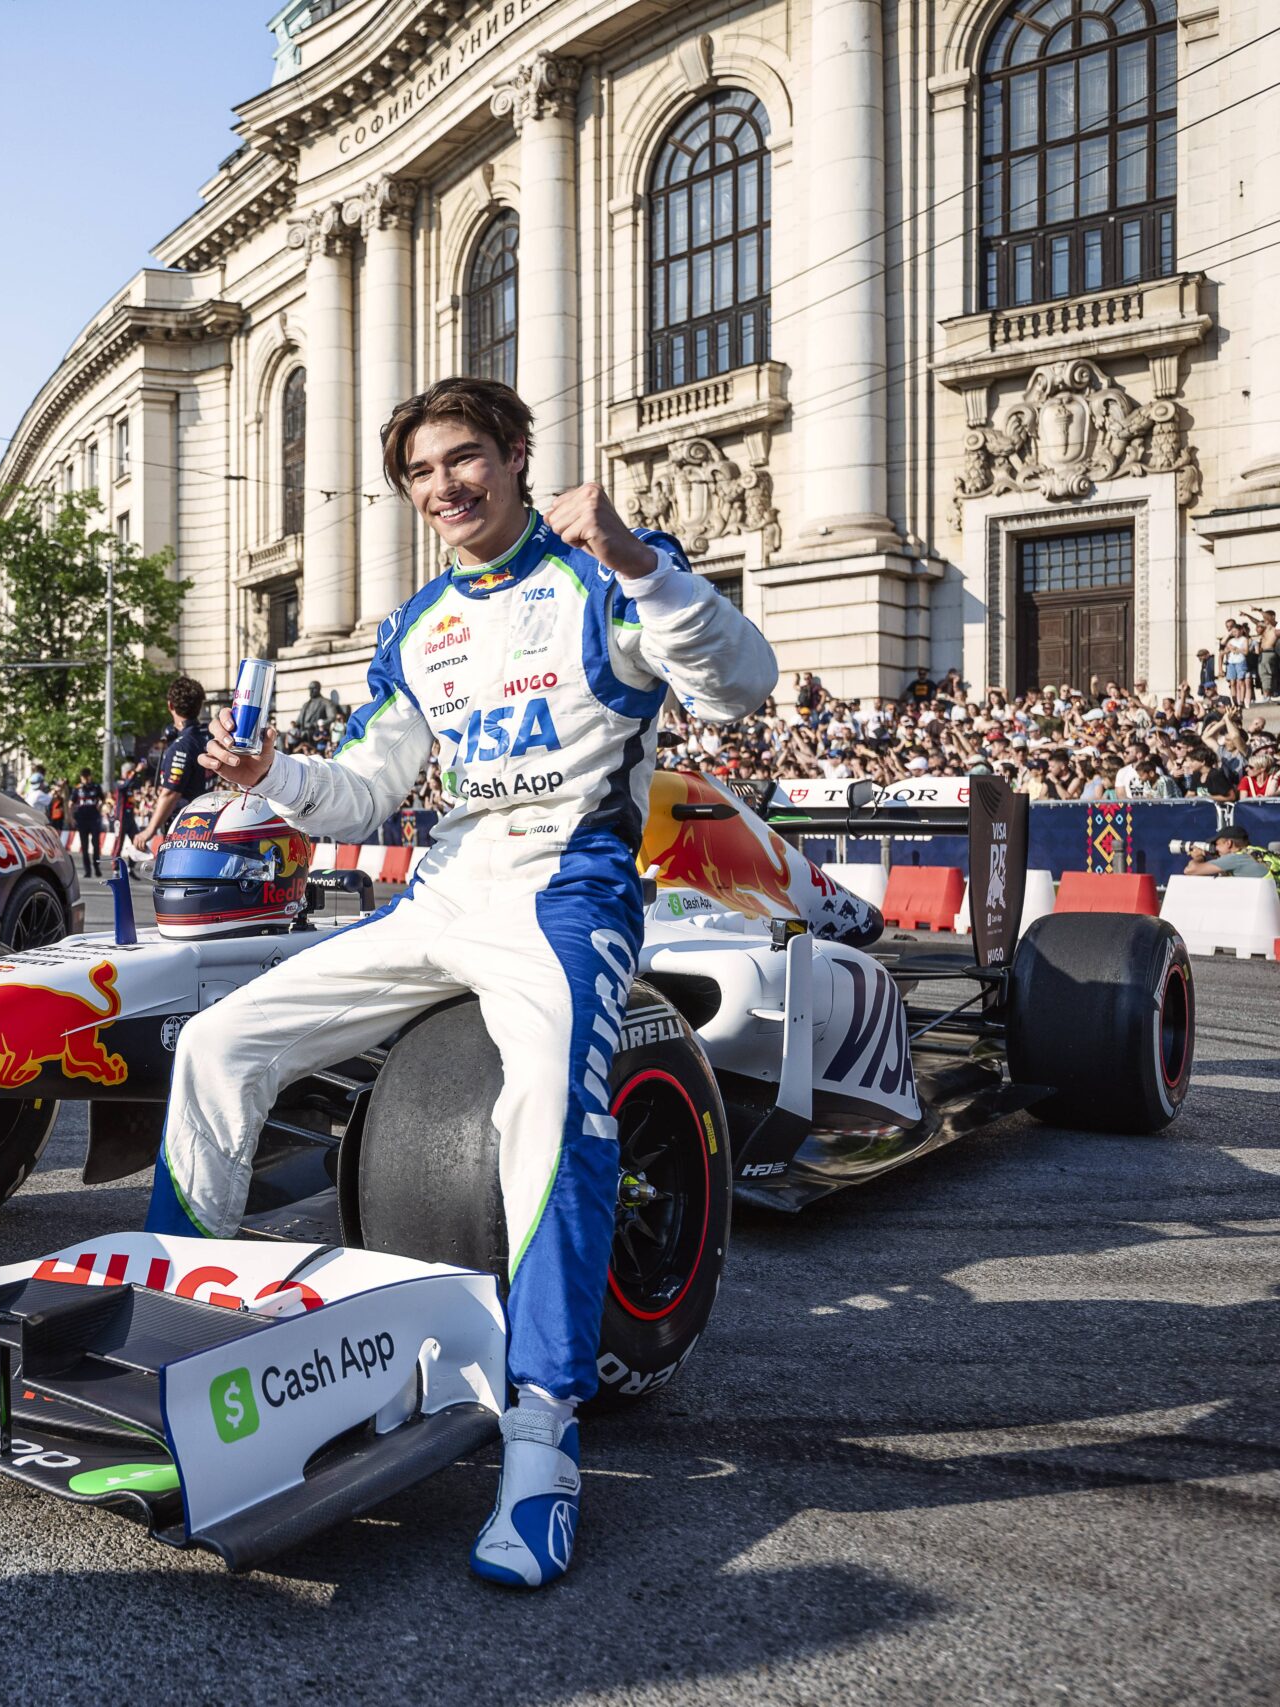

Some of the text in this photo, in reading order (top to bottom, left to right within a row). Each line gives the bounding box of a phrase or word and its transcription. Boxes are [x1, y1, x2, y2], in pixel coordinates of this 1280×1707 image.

[339, 0, 540, 154] СОФИЙСКИ УНИВЕ
[521, 588, 555, 601] VISA
[426, 654, 469, 674] HONDA
[504, 672, 558, 698] HUGO
[460, 771, 564, 799] Cash App
[824, 789, 939, 802] TDOR
[530, 824, 560, 835] TSOLOV
[992, 822, 1008, 841] VISA
[173, 840, 188, 848] YOU
[189, 840, 219, 851] WINGS
[987, 947, 1004, 965] HUGO
[822, 958, 917, 1099] VISA
[261, 1348, 336, 1408] Cash
[341, 1331, 395, 1379] App
